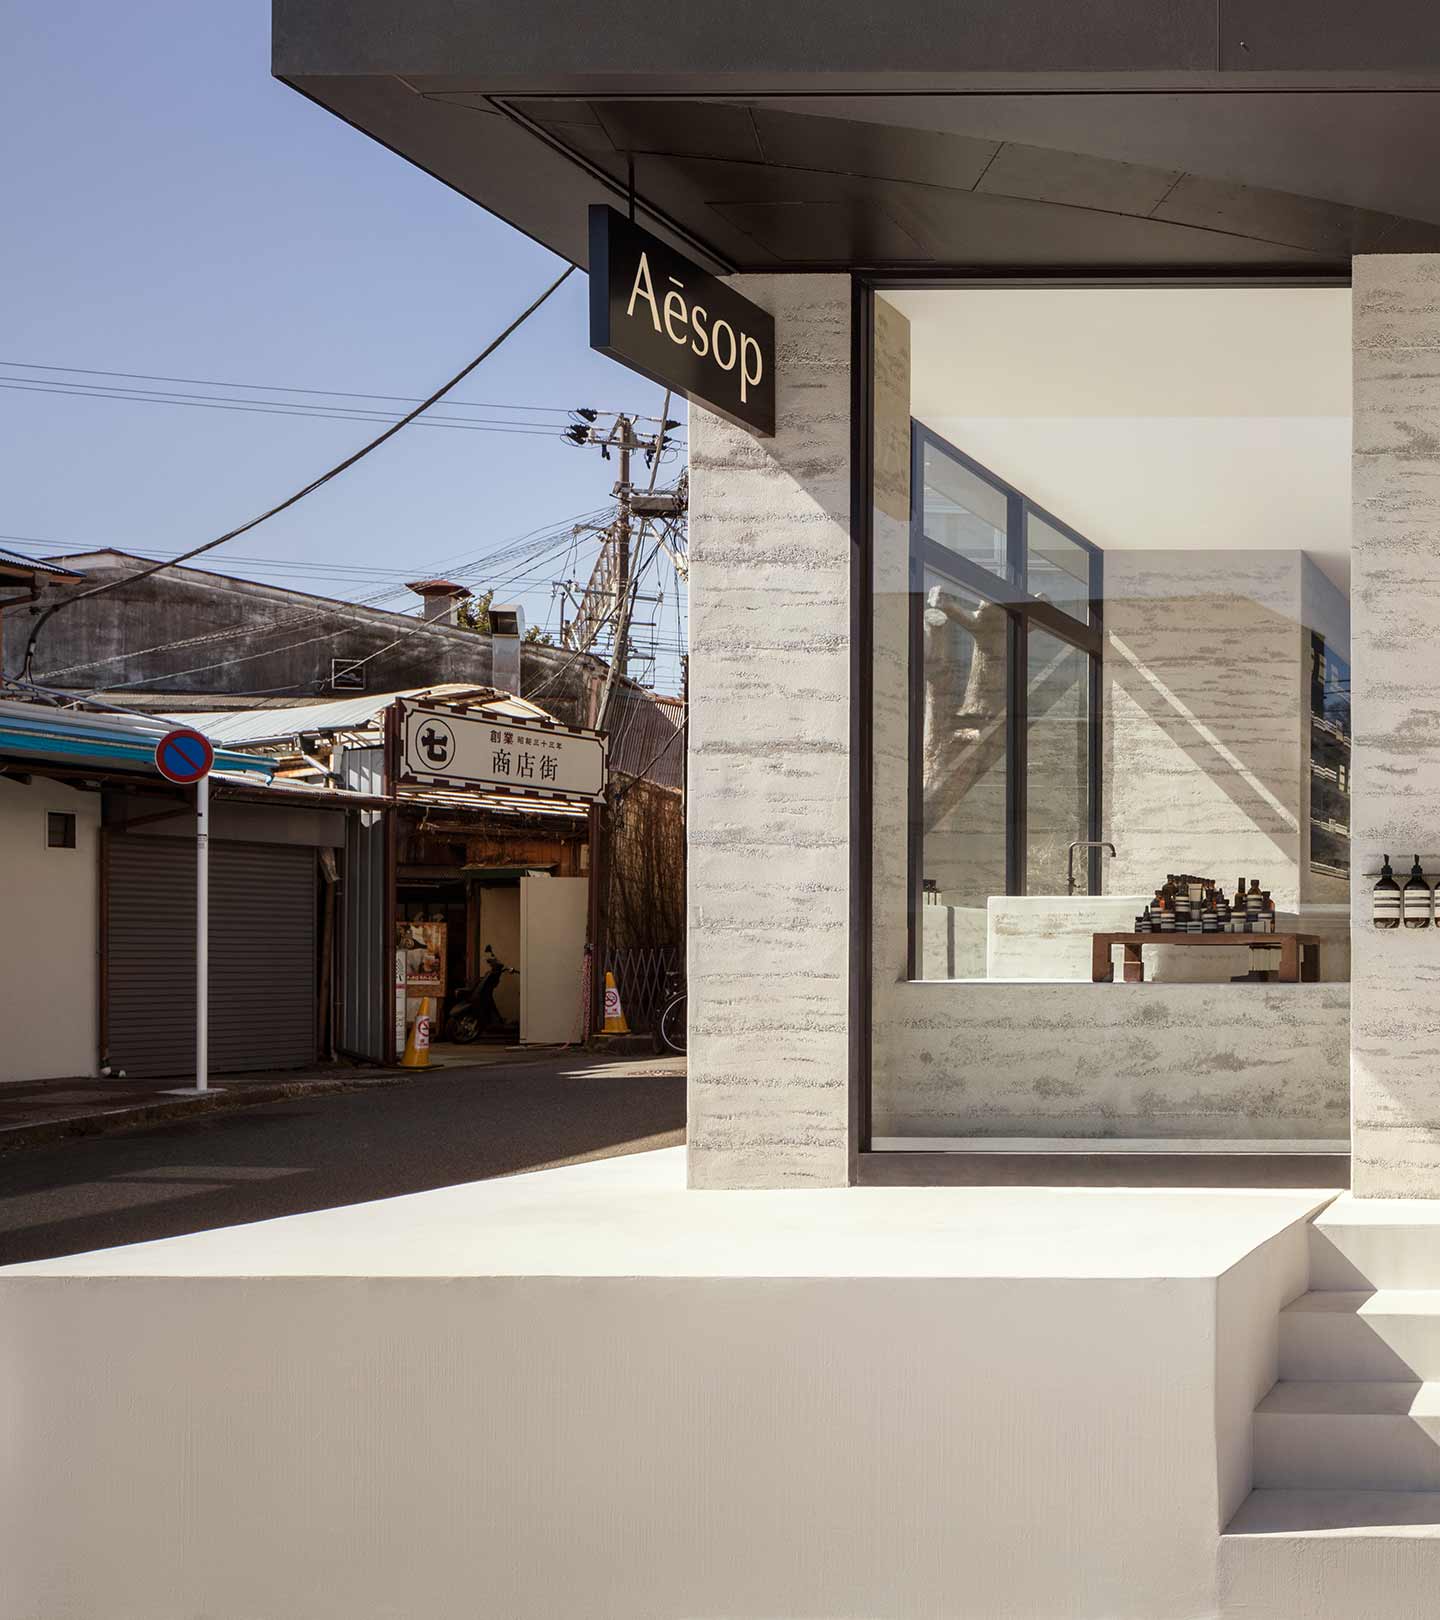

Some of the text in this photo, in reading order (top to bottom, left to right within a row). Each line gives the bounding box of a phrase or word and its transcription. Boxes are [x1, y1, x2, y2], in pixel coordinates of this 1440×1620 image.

[626, 251, 763, 404] Aēsop
[492, 748, 558, 781] 商店街
